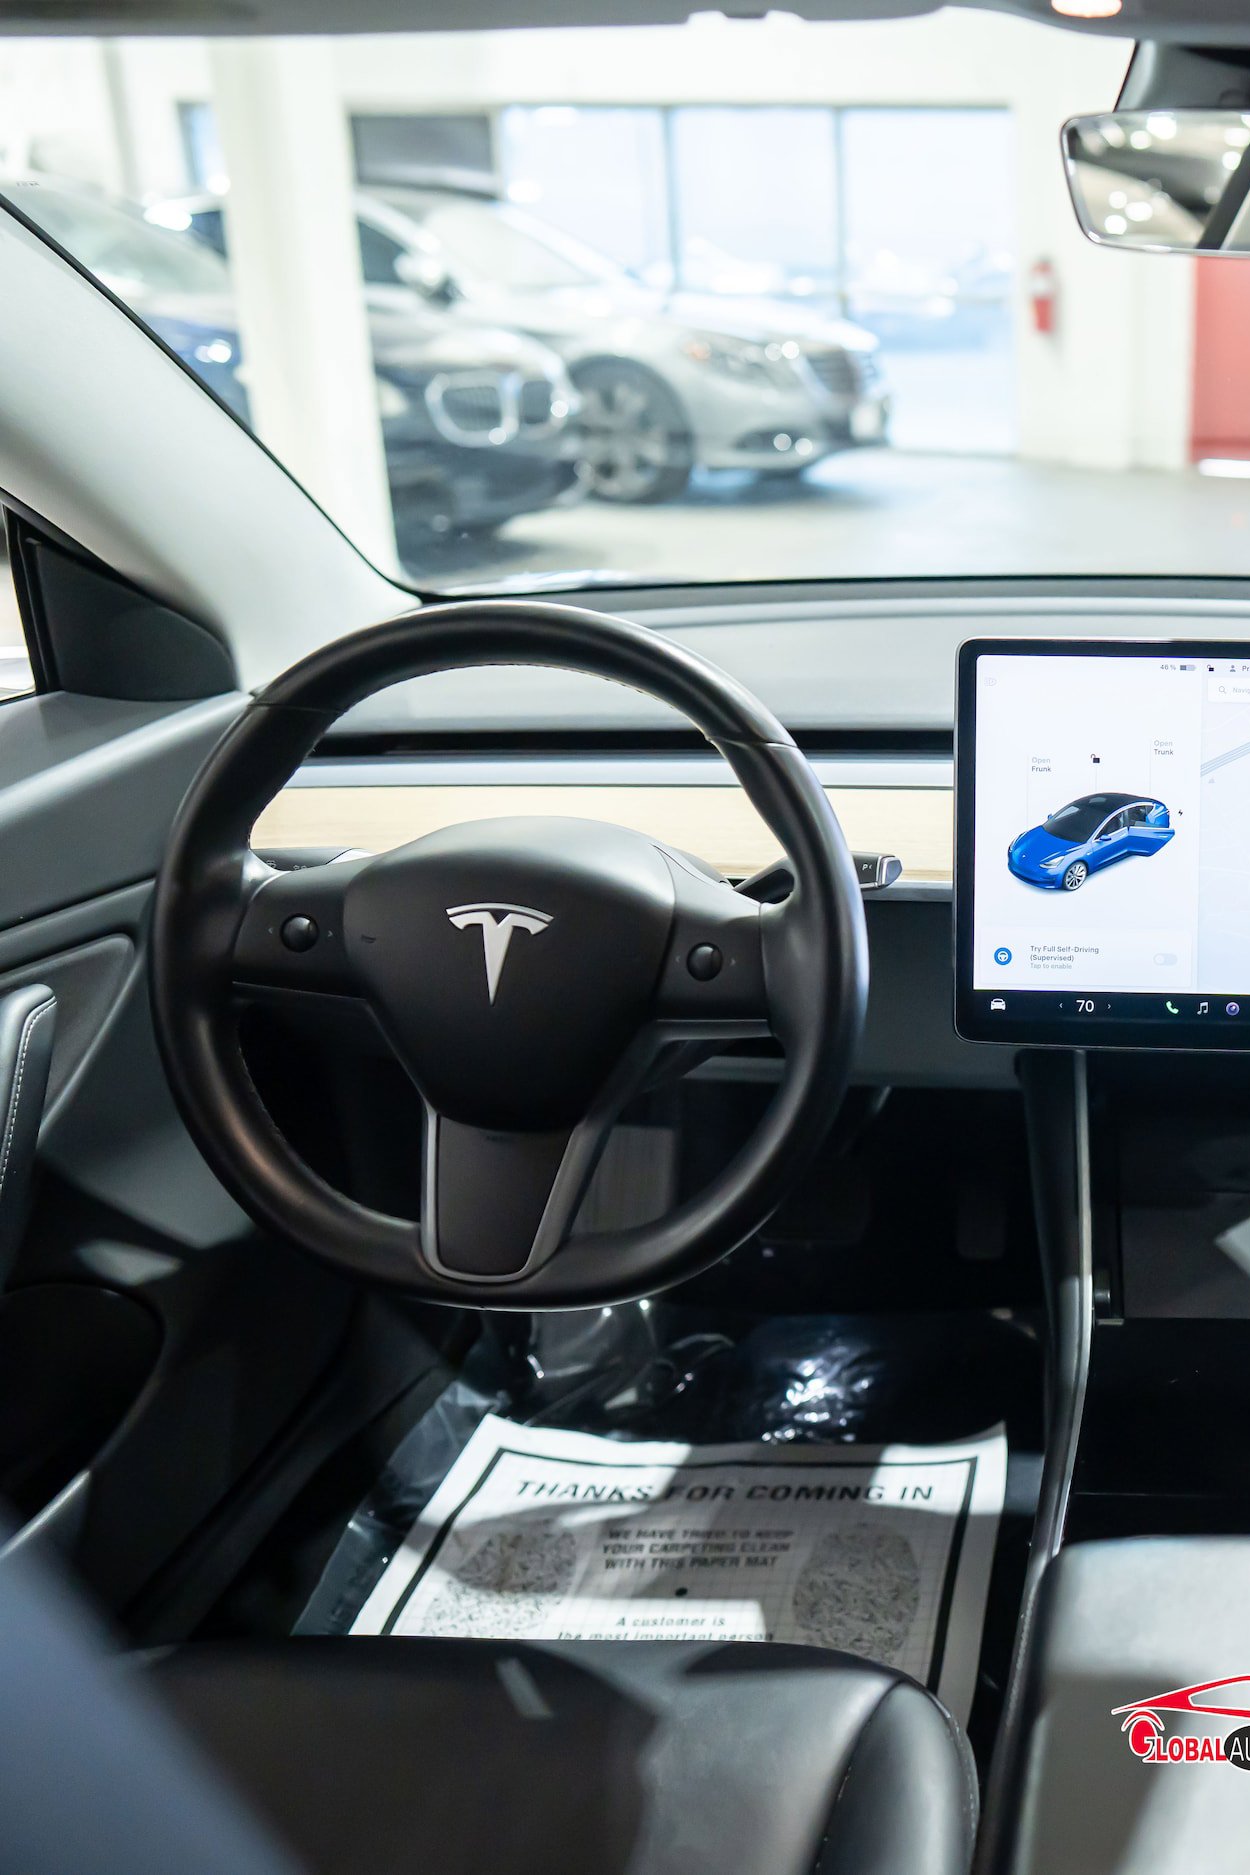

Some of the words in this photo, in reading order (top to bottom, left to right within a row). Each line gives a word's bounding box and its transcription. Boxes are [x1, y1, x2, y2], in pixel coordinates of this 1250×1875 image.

[1153, 740, 1173, 748] Open
[1031, 757, 1051, 765] Open
[1031, 765, 1052, 773] Frunk
[1030, 945, 1041, 953] Try
[1057, 946, 1099, 954] Self-Driving
[1030, 954, 1074, 962] (Supervised)
[1076, 1000, 1094, 1013] 70
[516, 1480, 651, 1501] THANKS
[663, 1484, 735, 1501] FOR
[745, 1484, 883, 1501] COMING
[899, 1485, 933, 1501] IN
[609, 1529, 632, 1540] WE
[636, 1529, 676, 1540] HAVE
[732, 1529, 750, 1539] TO
[603, 1543, 645, 1555] YOUR
[649, 1542, 738, 1554] CARPETING
[740, 1542, 792, 1553] CLEAN
[605, 1556, 646, 1570] WITH
[651, 1556, 685, 1570] THIS
[689, 1556, 742, 1569] PAPER
[744, 1556, 778, 1568] MAT
[615, 1616, 626, 1626] A
[632, 1617, 706, 1626] customer
[712, 1616, 726, 1626] is
